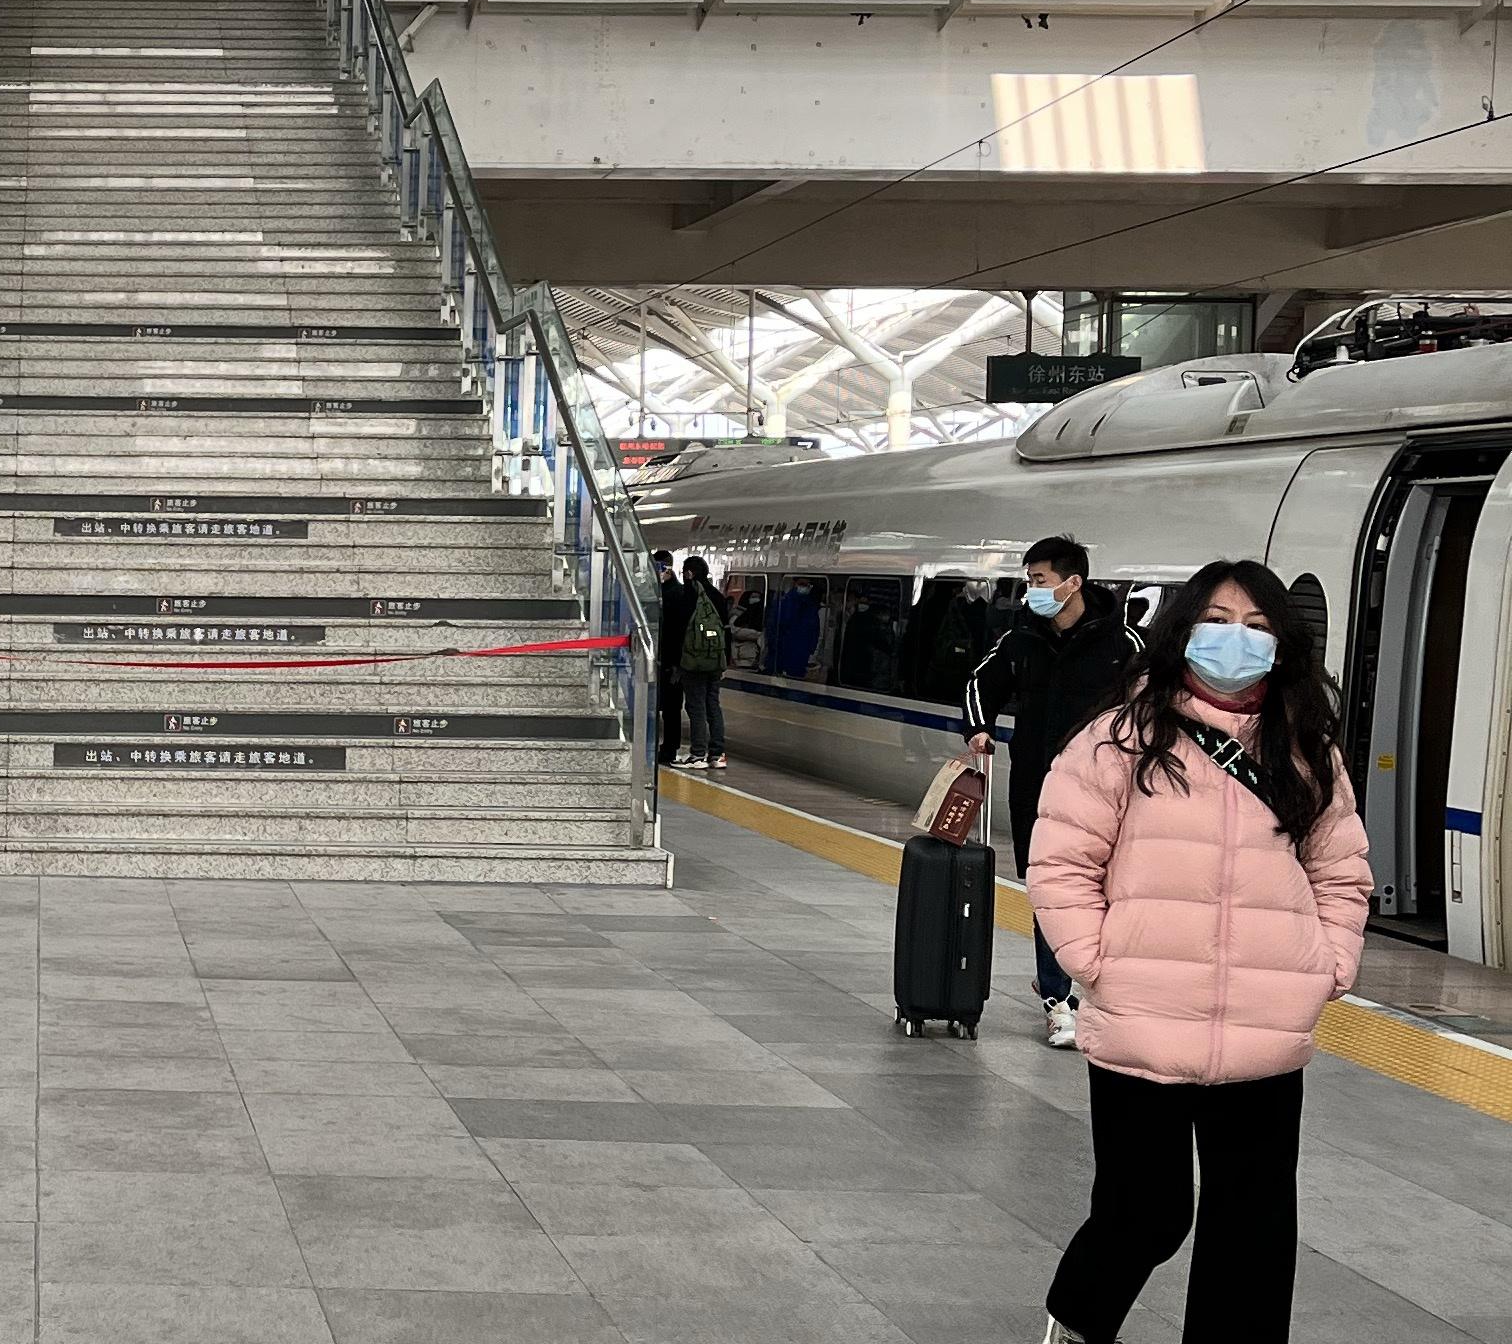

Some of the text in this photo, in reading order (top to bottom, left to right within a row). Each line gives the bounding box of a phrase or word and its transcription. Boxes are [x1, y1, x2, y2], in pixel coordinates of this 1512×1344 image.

[1028, 365, 1106, 384] 徐州东站
[166, 499, 197, 507] 旅客止步
[173, 600, 206, 608] 旅客止步
[388, 602, 421, 610] 旅客止步
[183, 716, 218, 726] 旅客止步
[412, 719, 449, 729] 旅客止步
[86, 750, 314, 765] 出站、中转换乘旅客请走旅客地道。
